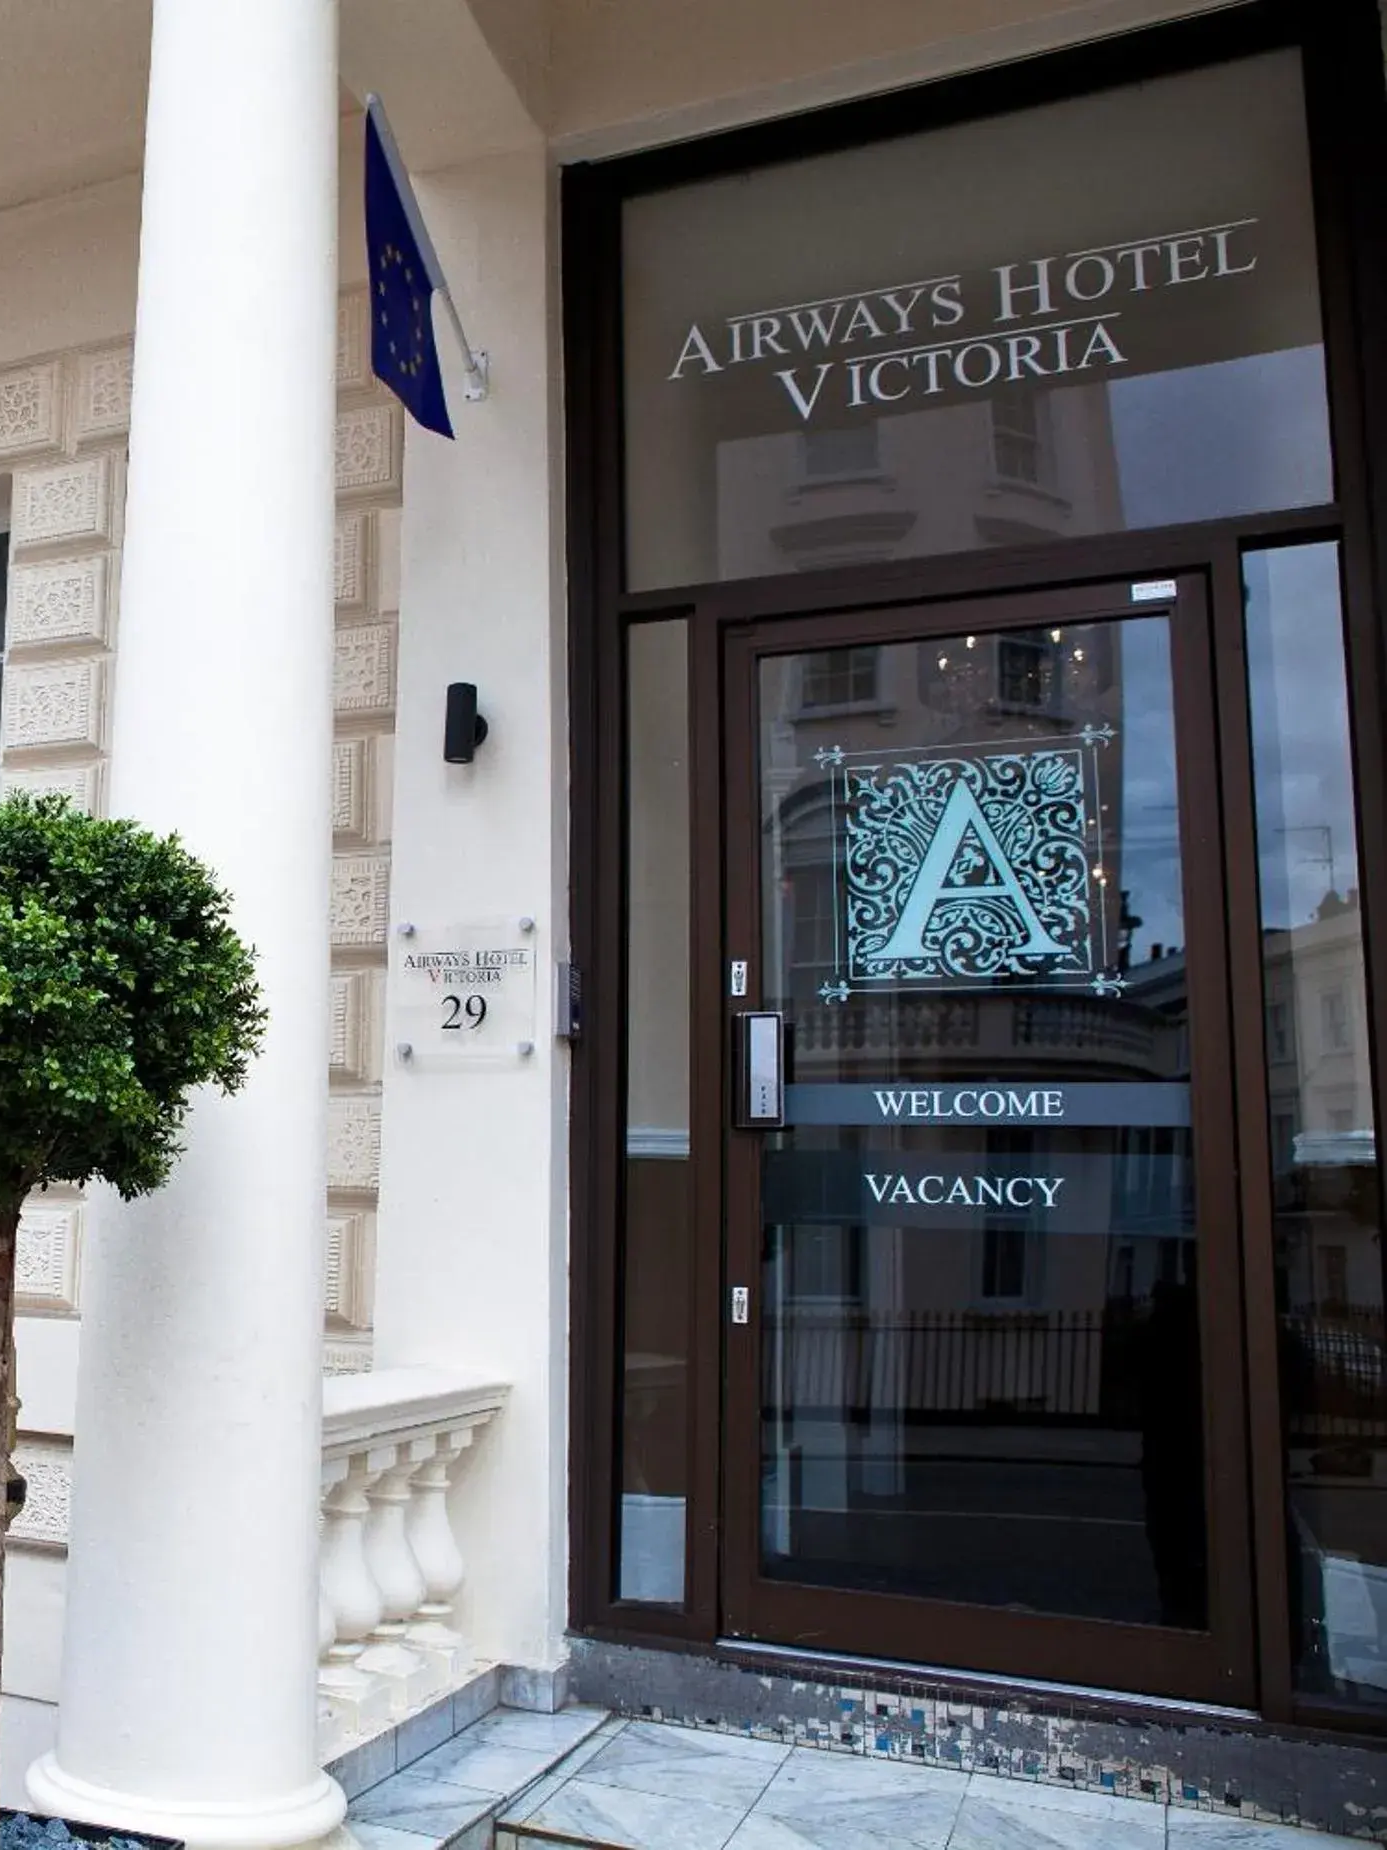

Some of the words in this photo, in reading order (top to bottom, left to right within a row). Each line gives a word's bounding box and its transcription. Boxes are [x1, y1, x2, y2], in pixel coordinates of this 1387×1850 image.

[668, 281, 965, 381] AIRWAYS
[993, 230, 1256, 320] HOTEL
[776, 321, 1127, 420] VICTORIA
[867, 777, 1072, 960] A
[404, 952, 470, 968] AIRWAYS
[476, 951, 527, 967] HOTEL
[428, 969, 501, 984] VICTORIA
[441, 994, 487, 1030] 29
[874, 1090, 1064, 1118] WELCOME
[865, 1174, 1066, 1208] VACANCY
